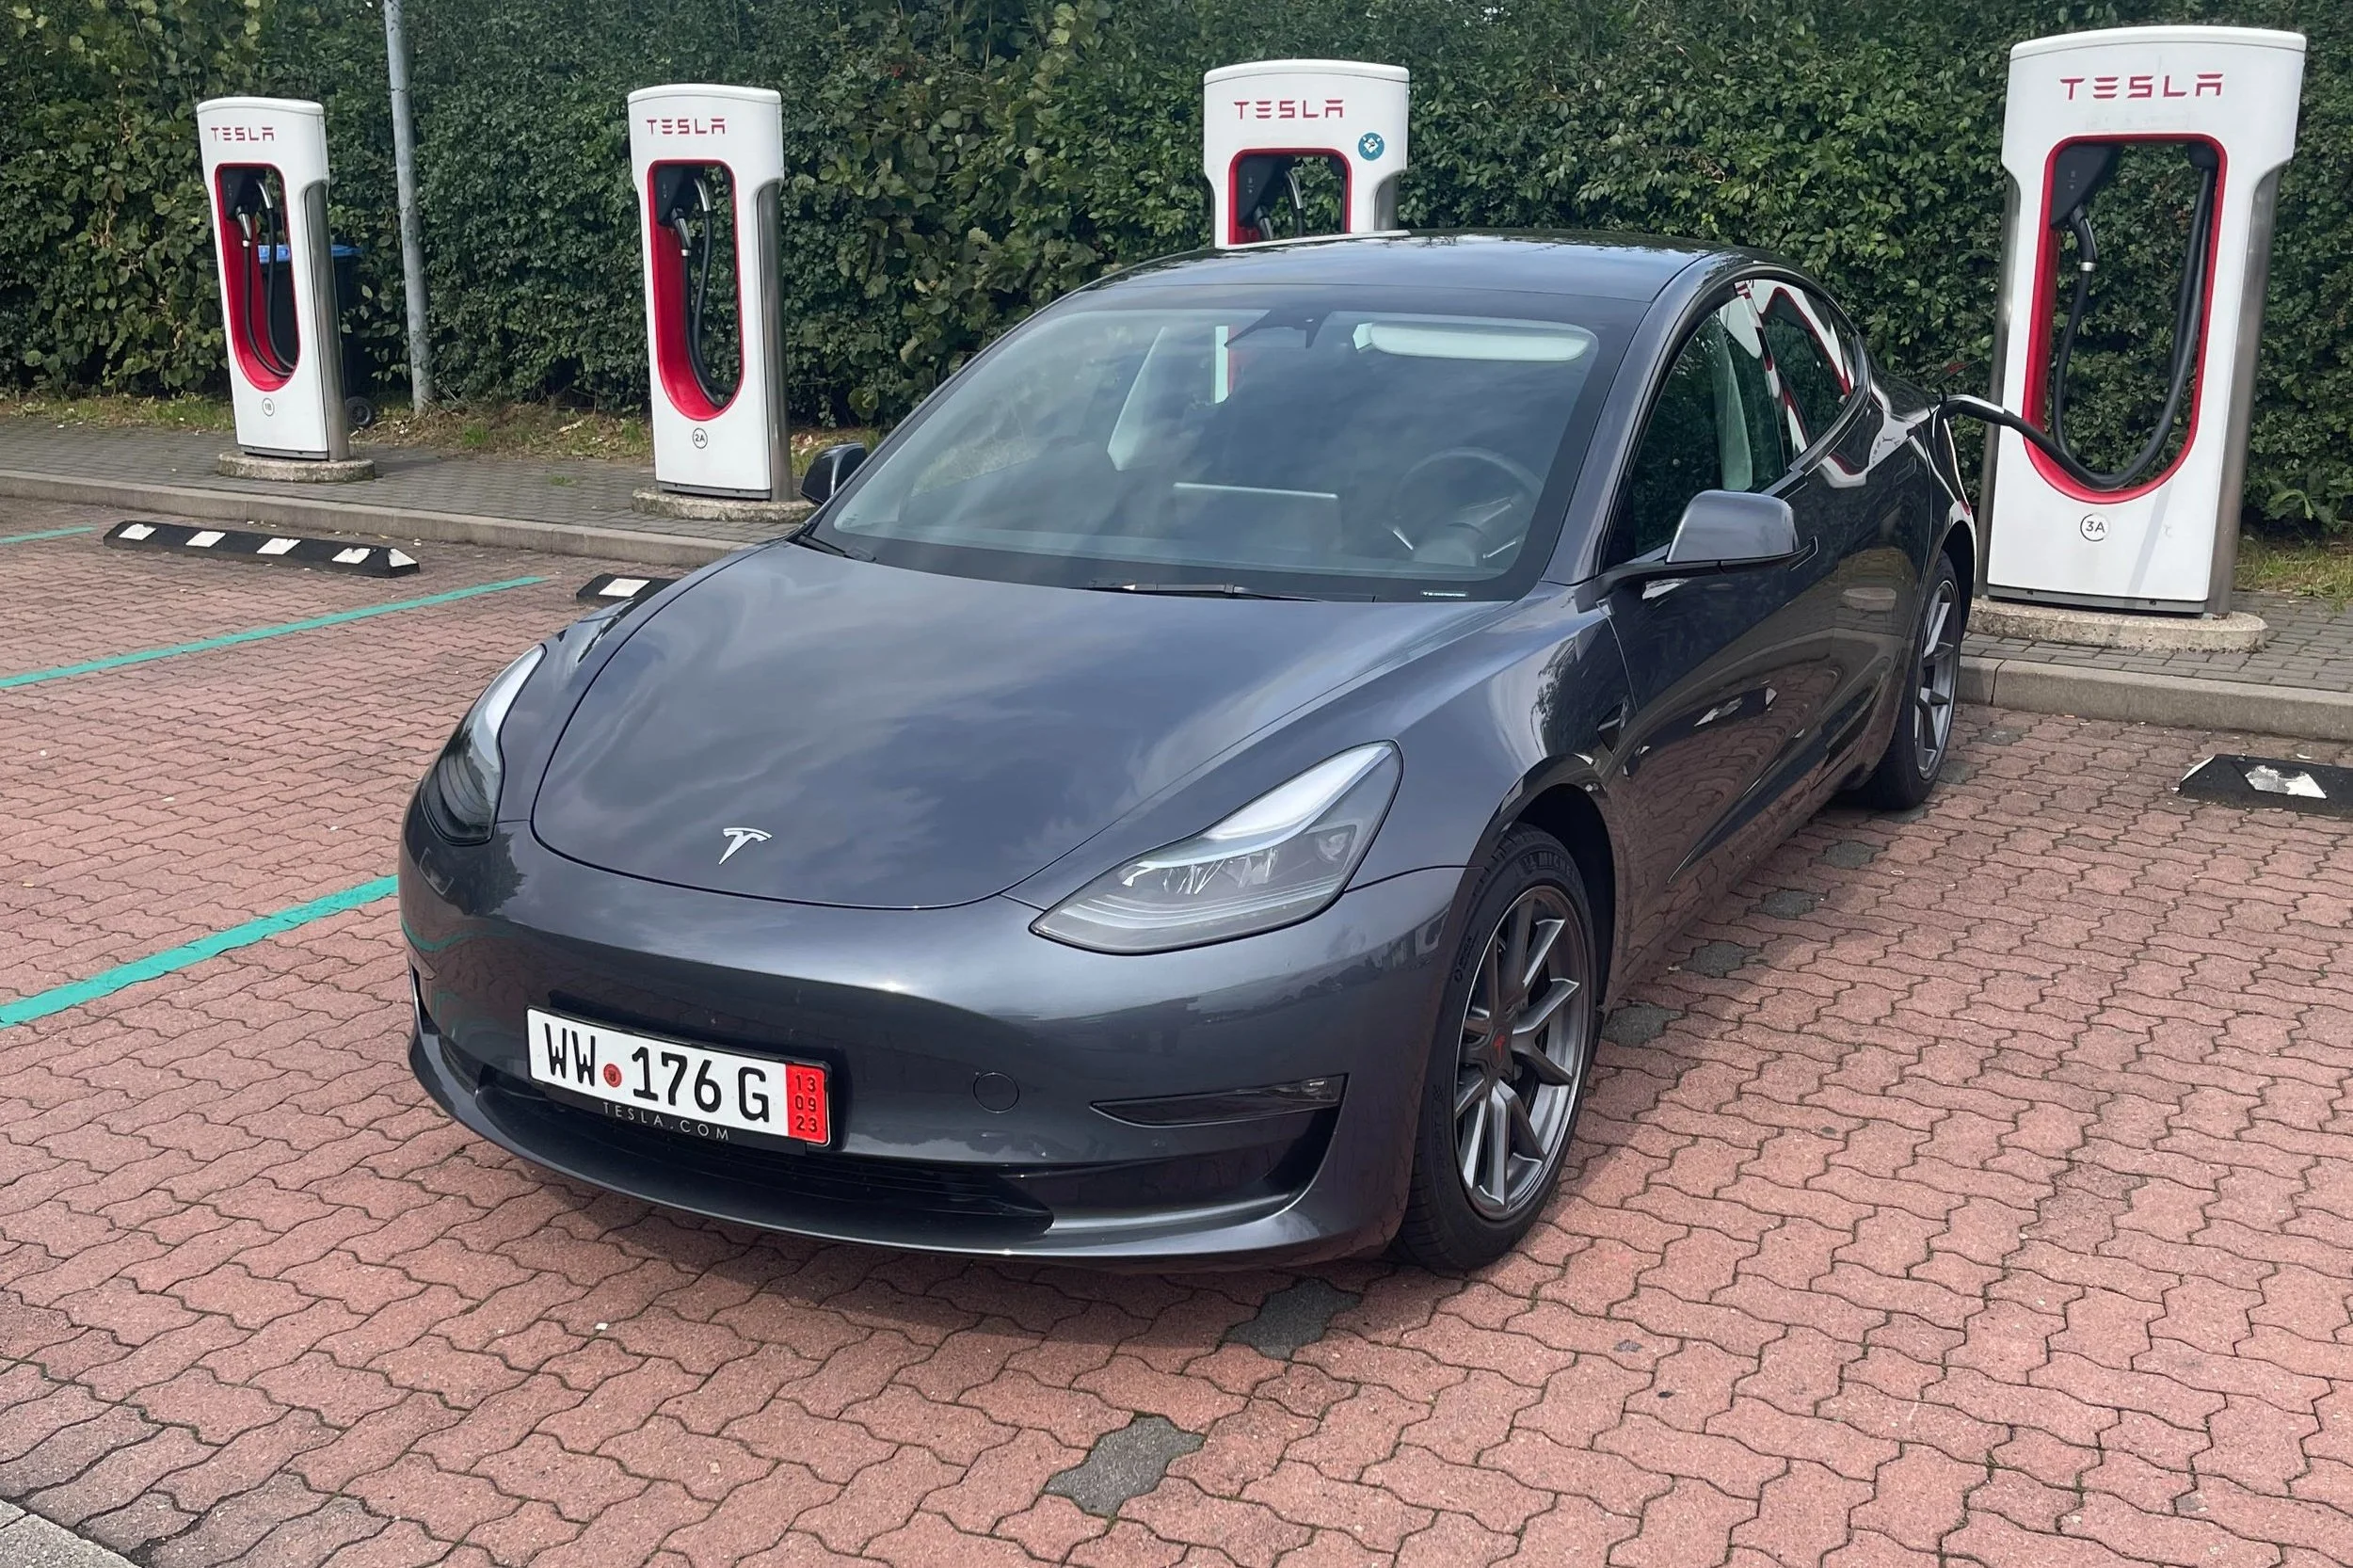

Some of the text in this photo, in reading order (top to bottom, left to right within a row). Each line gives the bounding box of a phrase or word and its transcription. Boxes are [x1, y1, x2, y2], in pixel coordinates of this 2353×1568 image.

[2059, 73, 2224, 101] TESLA
[1233, 99, 1344, 120] TESLA
[210, 126, 275, 142] TESLA
[646, 118, 726, 135] TESLA
[695, 433, 706, 442] 2A
[2085, 520, 2106, 534] 3A
[543, 1022, 770, 1123] WW 176 G
[795, 1074, 817, 1093] 13
[794, 1095, 817, 1112] 09
[602, 1101, 729, 1142] TESLA.COM
[795, 1114, 818, 1133] 23
